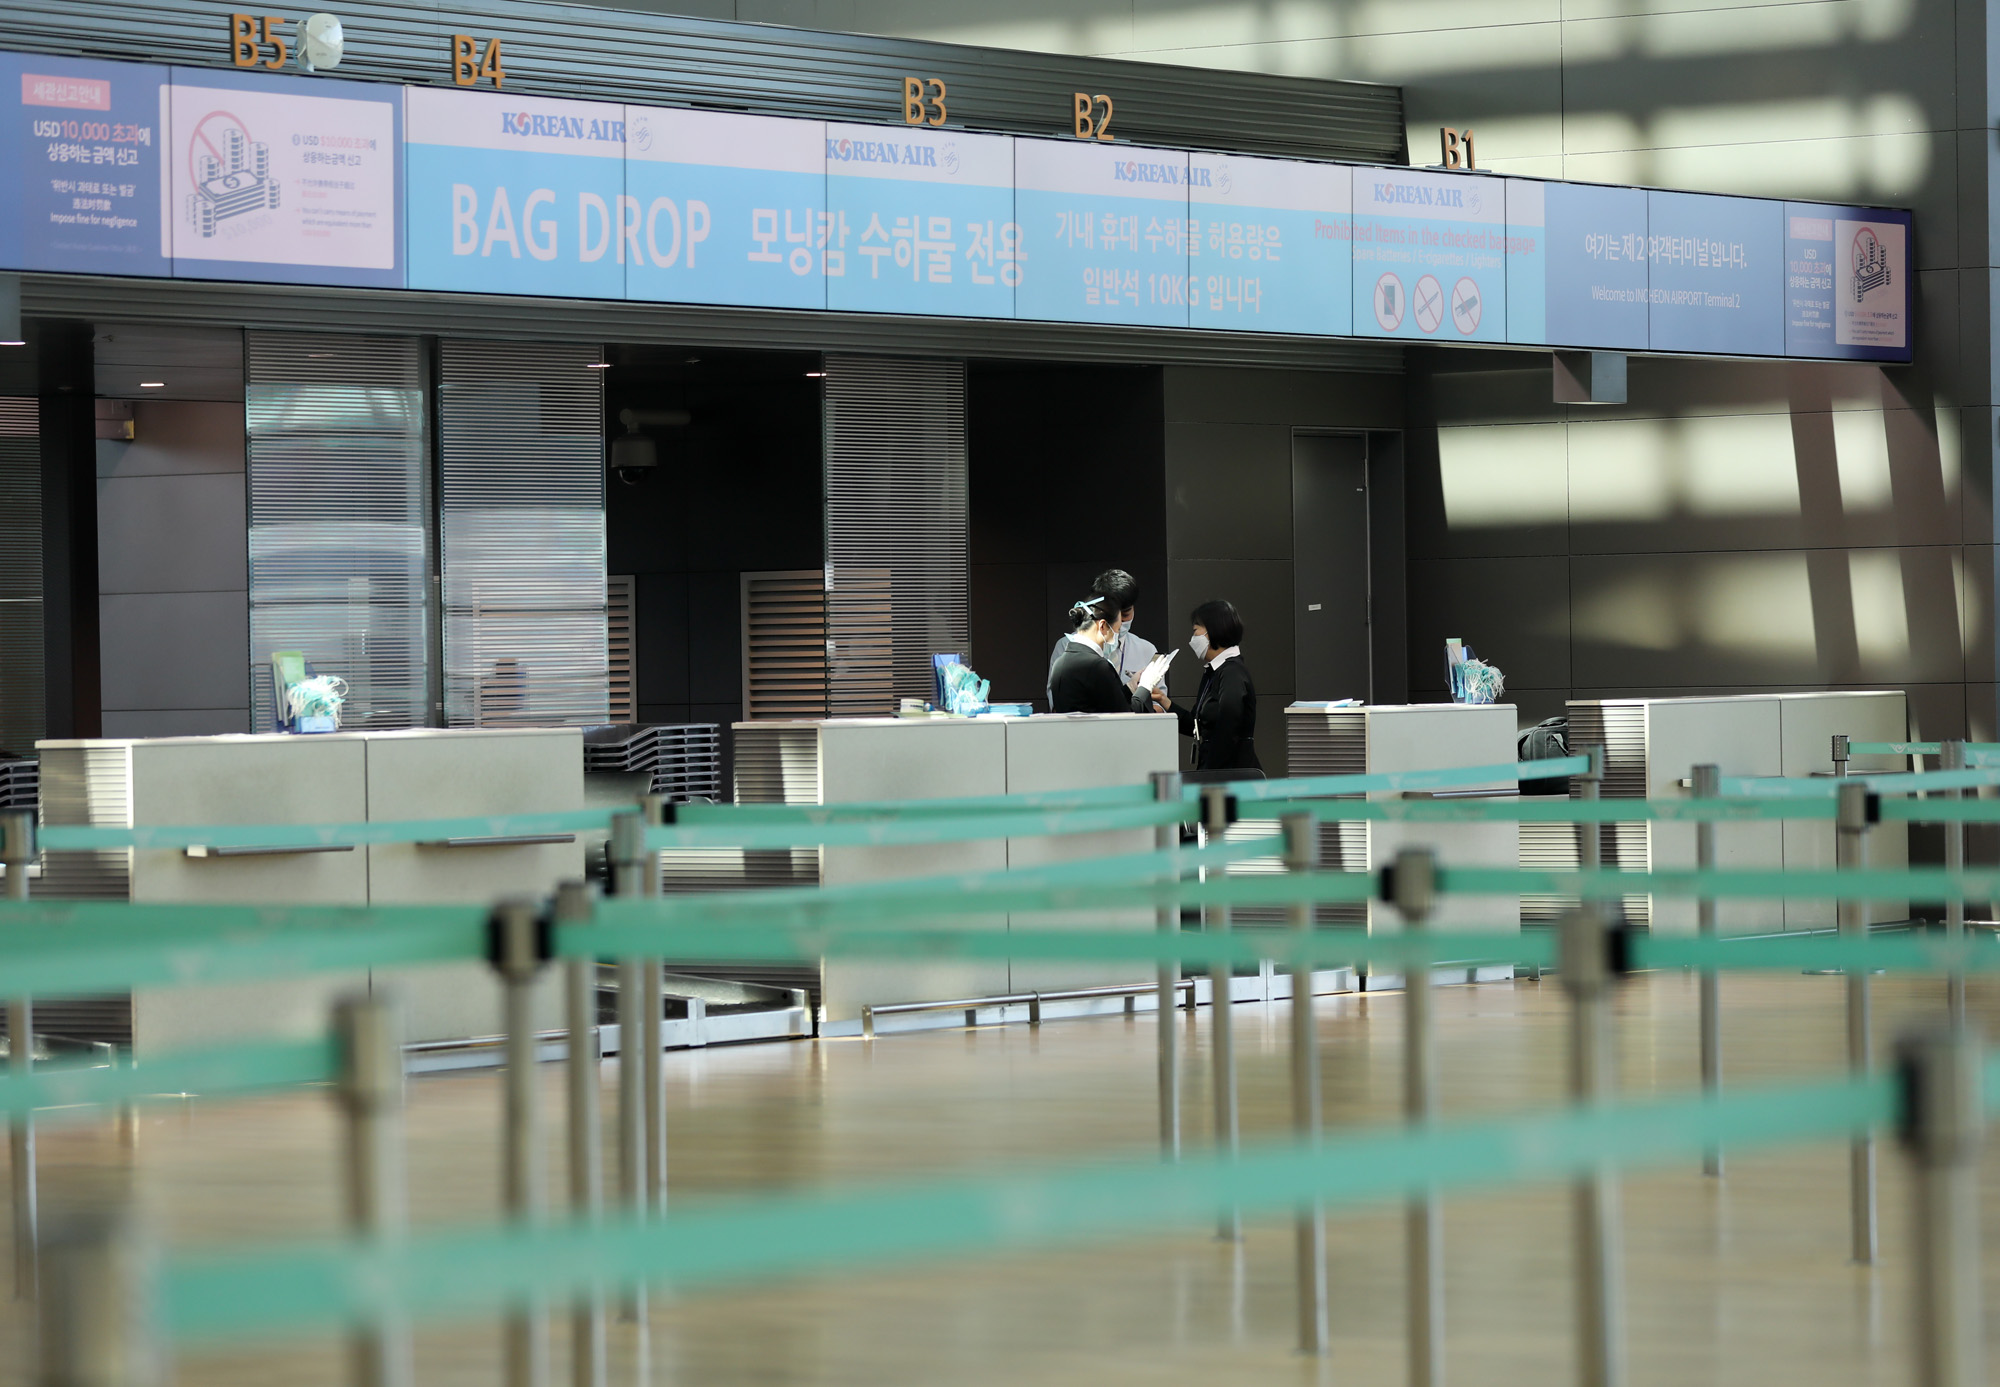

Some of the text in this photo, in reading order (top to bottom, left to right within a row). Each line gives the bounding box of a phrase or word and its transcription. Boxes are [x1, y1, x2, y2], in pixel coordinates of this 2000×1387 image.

[230, 13, 286, 69] B5
[451, 34, 506, 89] B4
[903, 77, 947, 126] B3
[1074, 92, 1115, 141] B2
[112, 122, 151, 146] 초과에
[302, 135, 319, 146] USD
[502, 112, 584, 139] KOREAN
[587, 119, 627, 143] AIR
[47, 142, 139, 165] 상응하는 금액 신고
[826, 139, 899, 164] KOREAN
[901, 144, 937, 167] AIR
[1440, 127, 1476, 171] B1
[1114, 161, 1178, 185] KOREAN
[1180, 166, 1212, 187] AIR
[1374, 183, 1432, 206] KOREAN
[1435, 187, 1463, 208] AIR
[452, 183, 711, 268] BAG DROP
[1055, 210, 1283, 262] 기내 휴대 수하물 허용량은
[1315, 219, 1373, 242] Prohibited
[1408, 225, 1418, 245] in
[1421, 226, 1439, 246] the
[1442, 228, 1486, 249] checked
[1489, 230, 1535, 255] baggage
[748, 207, 1029, 287] 모닝캄 수하물 전용
[1352, 245, 1375, 262] Spare
[1376, 247, 1411, 263] Batteries
[1418, 249, 1464, 267] E-cigarettes
[1471, 252, 1501, 270] Lighters
[1585, 233, 1620, 261] 여기는
[1647, 235, 1709, 267] 여객터미널
[1711, 242, 1747, 269] 입니다.
[1804, 249, 1816, 259] USD
[1083, 267, 1263, 314] 일반석 10KG 입니다
[1592, 285, 1741, 308] Welcome to INCHEON AIRPORT Terminal 2
